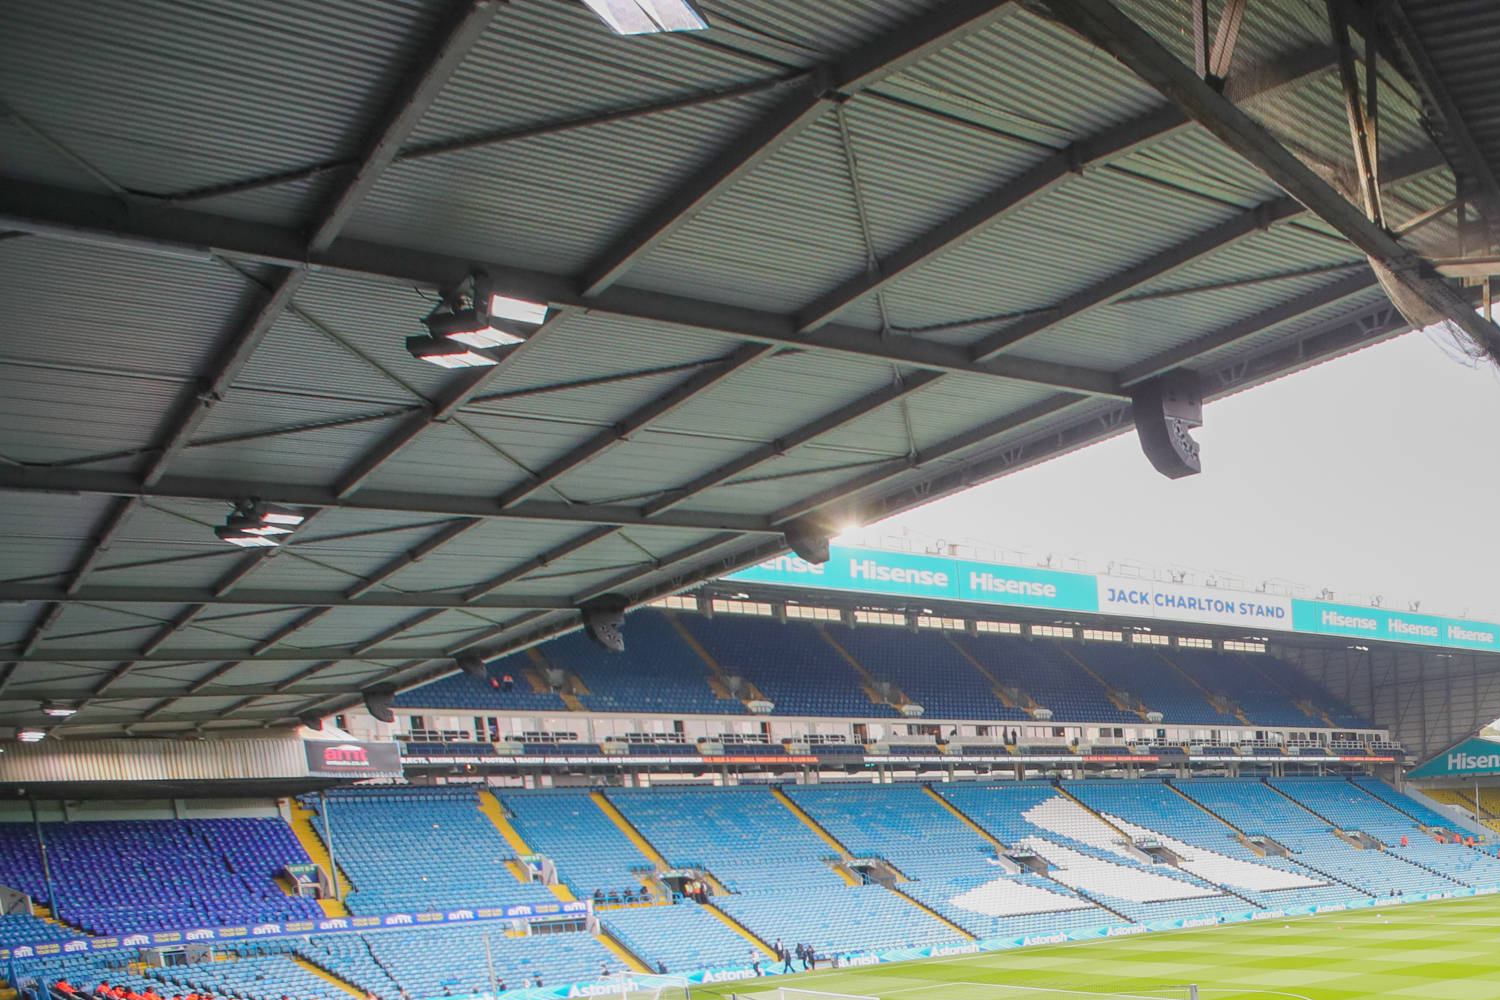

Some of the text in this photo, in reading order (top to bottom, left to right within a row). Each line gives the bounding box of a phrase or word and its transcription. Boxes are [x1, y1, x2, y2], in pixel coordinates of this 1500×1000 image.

[849, 558, 948, 587] Hisense
[969, 571, 1057, 597] Hisense
[1107, 588, 1285, 620] JACK CHARLTON STAND
[1321, 610, 1377, 632] Hisense
[1387, 617, 1439, 638] Hisense
[1447, 624, 1494, 644] Hisense
[323, 746, 368, 762] amt
[186, 929, 215, 940] amt
[252, 924, 281, 935] amt
[319, 919, 348, 930] amt
[1022, 931, 1067, 947] Astonish
[928, 942, 979, 957] Astonish
[567, 978, 638, 998] Astonish
